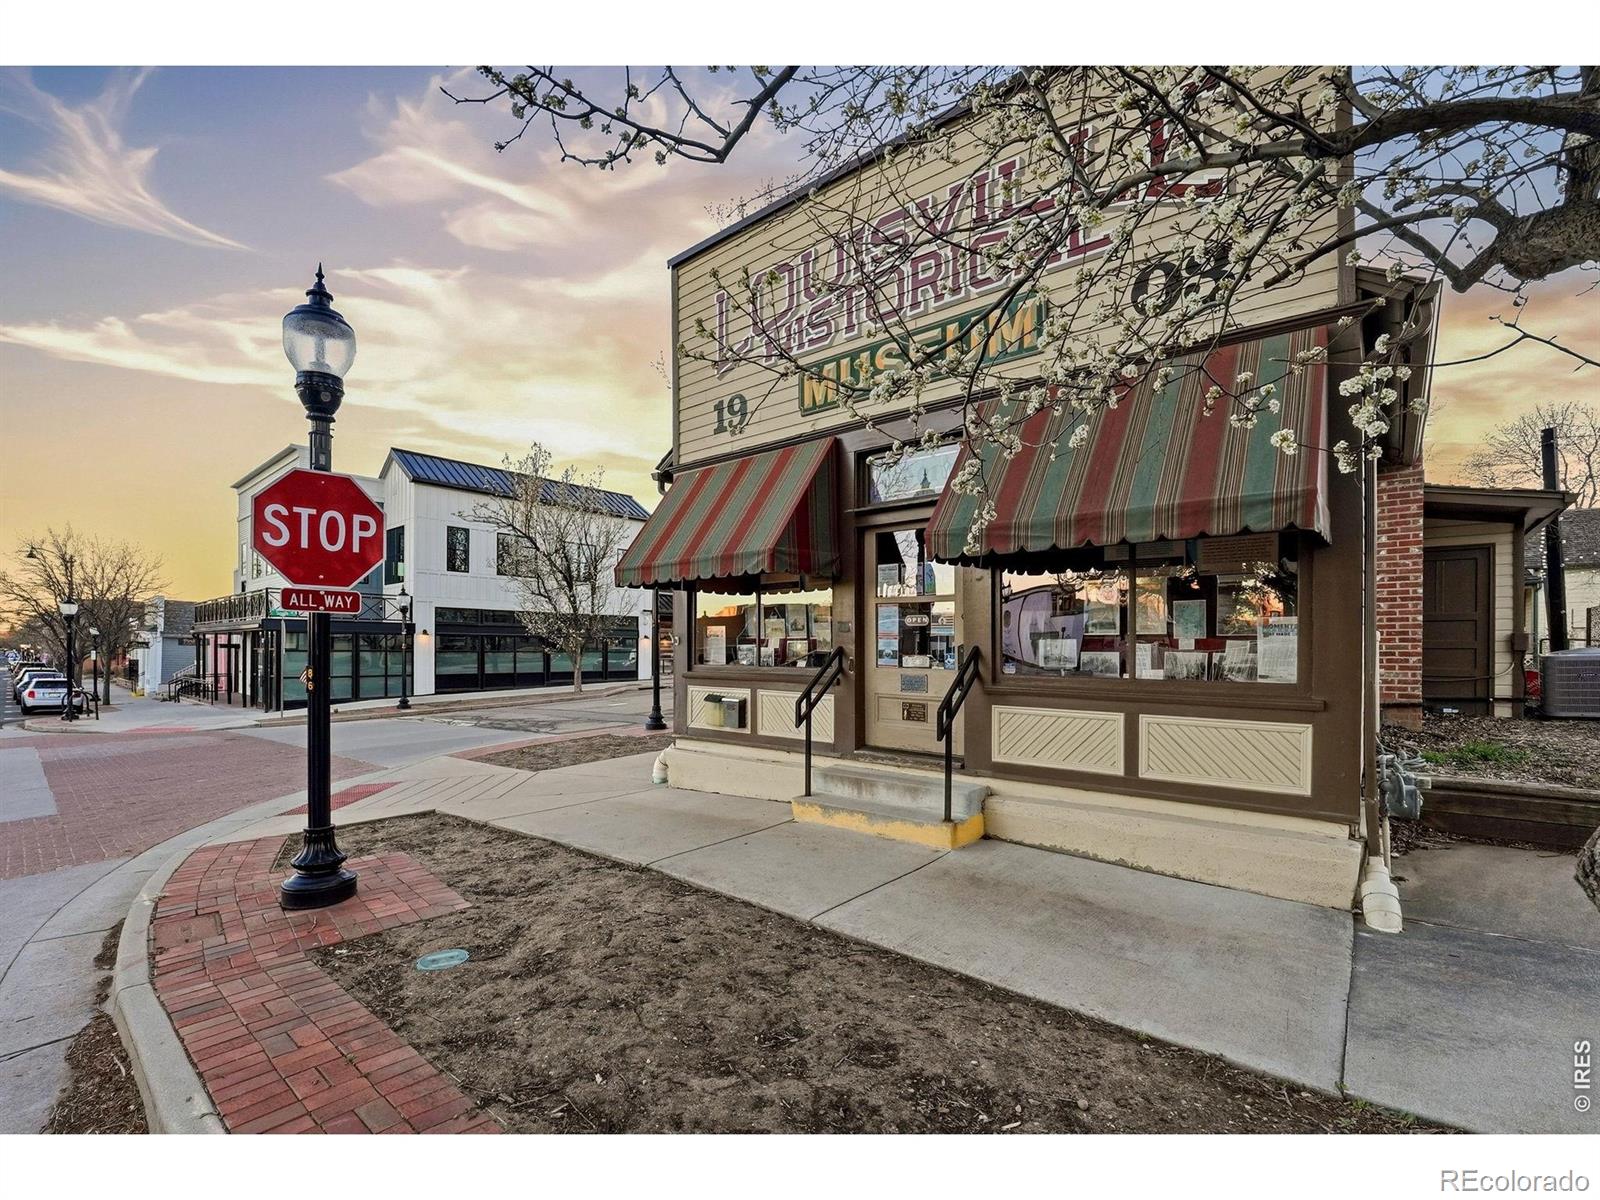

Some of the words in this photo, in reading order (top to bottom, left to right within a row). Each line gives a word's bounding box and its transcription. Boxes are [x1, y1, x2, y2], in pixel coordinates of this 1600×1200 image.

[713, 70, 1230, 378] LOUISVILLE
[714, 393, 748, 437] 19
[262, 503, 377, 553] STOP
[289, 593, 317, 607] ALL
[324, 594, 353, 609] WAY
[906, 616, 929, 624] OPEN
